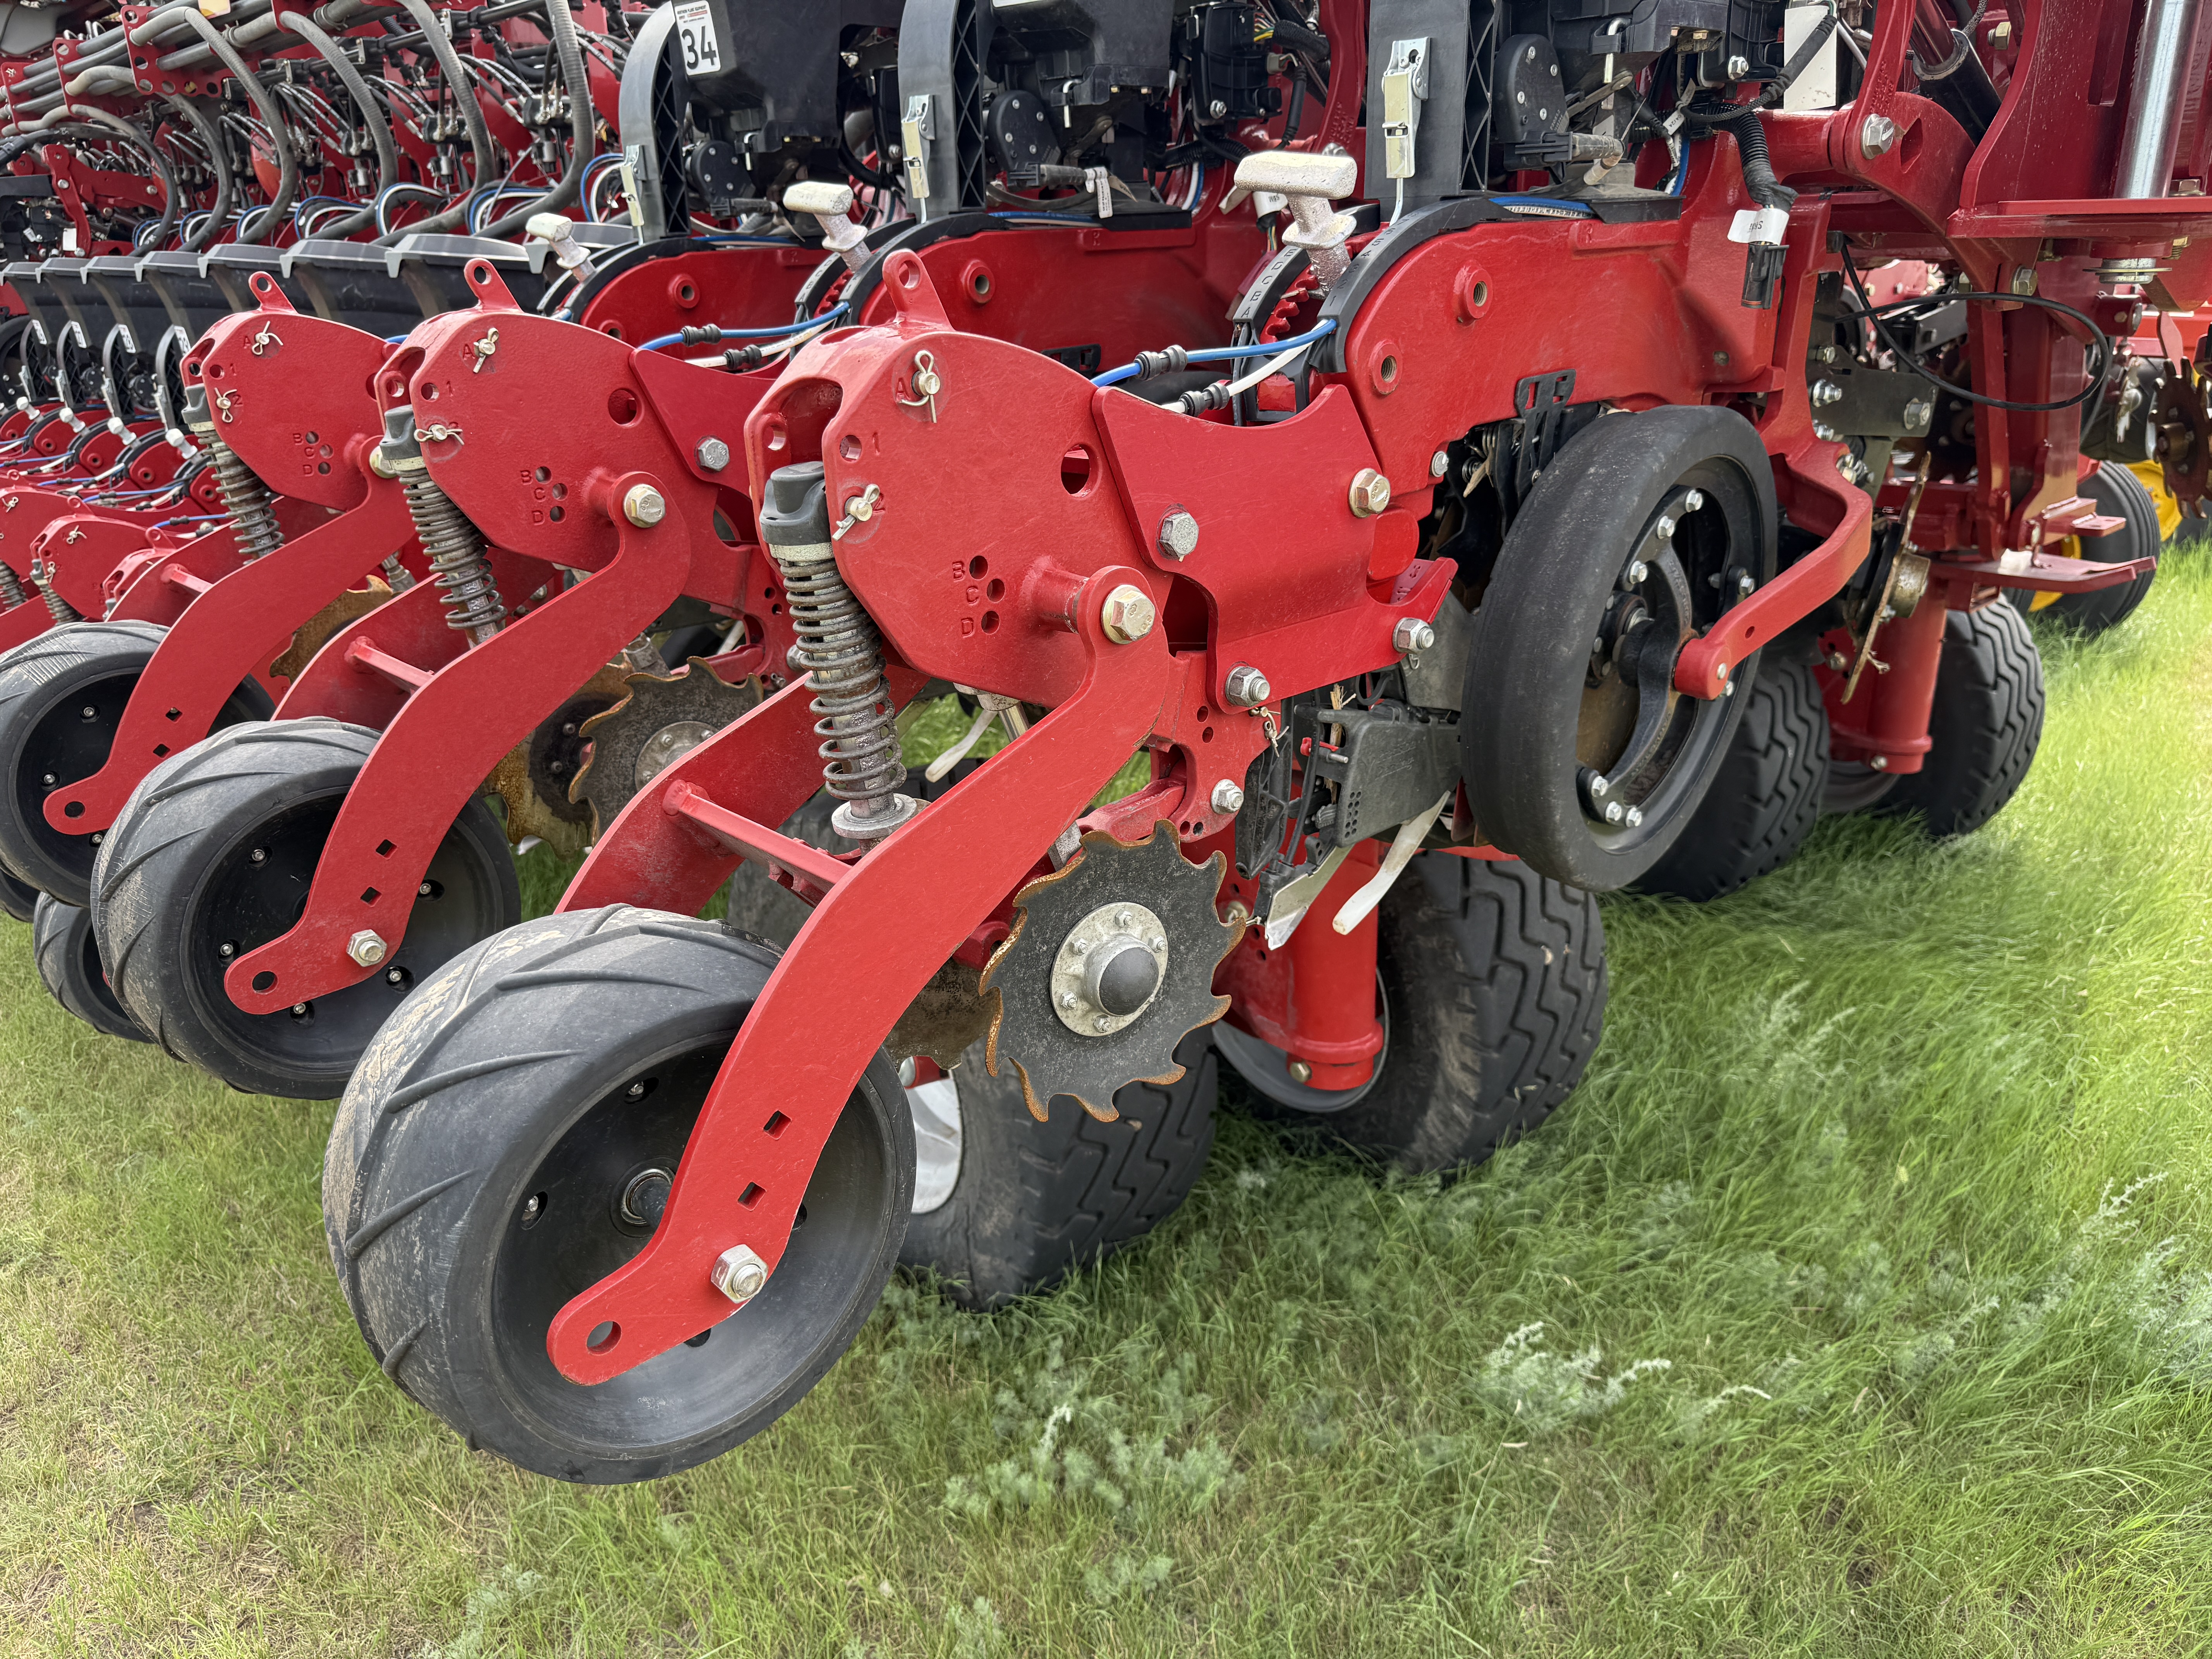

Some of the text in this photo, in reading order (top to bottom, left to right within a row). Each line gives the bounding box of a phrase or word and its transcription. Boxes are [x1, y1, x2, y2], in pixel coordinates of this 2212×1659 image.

[682, 26, 717, 70] 34
[1329, 295, 1337, 306] 1
[1337, 279, 1348, 289] 2
[1348, 264, 1360, 273] 3
[1372, 238, 1384, 246] 5
[1241, 249, 1297, 318] A B C D E
[244, 335, 251, 349] A
[463, 344, 475, 361] A
[230, 363, 237, 376] 1
[447, 381, 454, 397] 1
[896, 377, 911, 403] A
[233, 394, 244, 407] 2
[292, 433, 304, 445] B
[872, 432, 881, 456] 1
[304, 447, 315, 459] C
[302, 464, 314, 477] D
[520, 469, 533, 485] B
[534, 487, 546, 502] C
[532, 510, 544, 526] D
[952, 561, 966, 582] B
[966, 586, 979, 606] C
[961, 617, 975, 638] D
